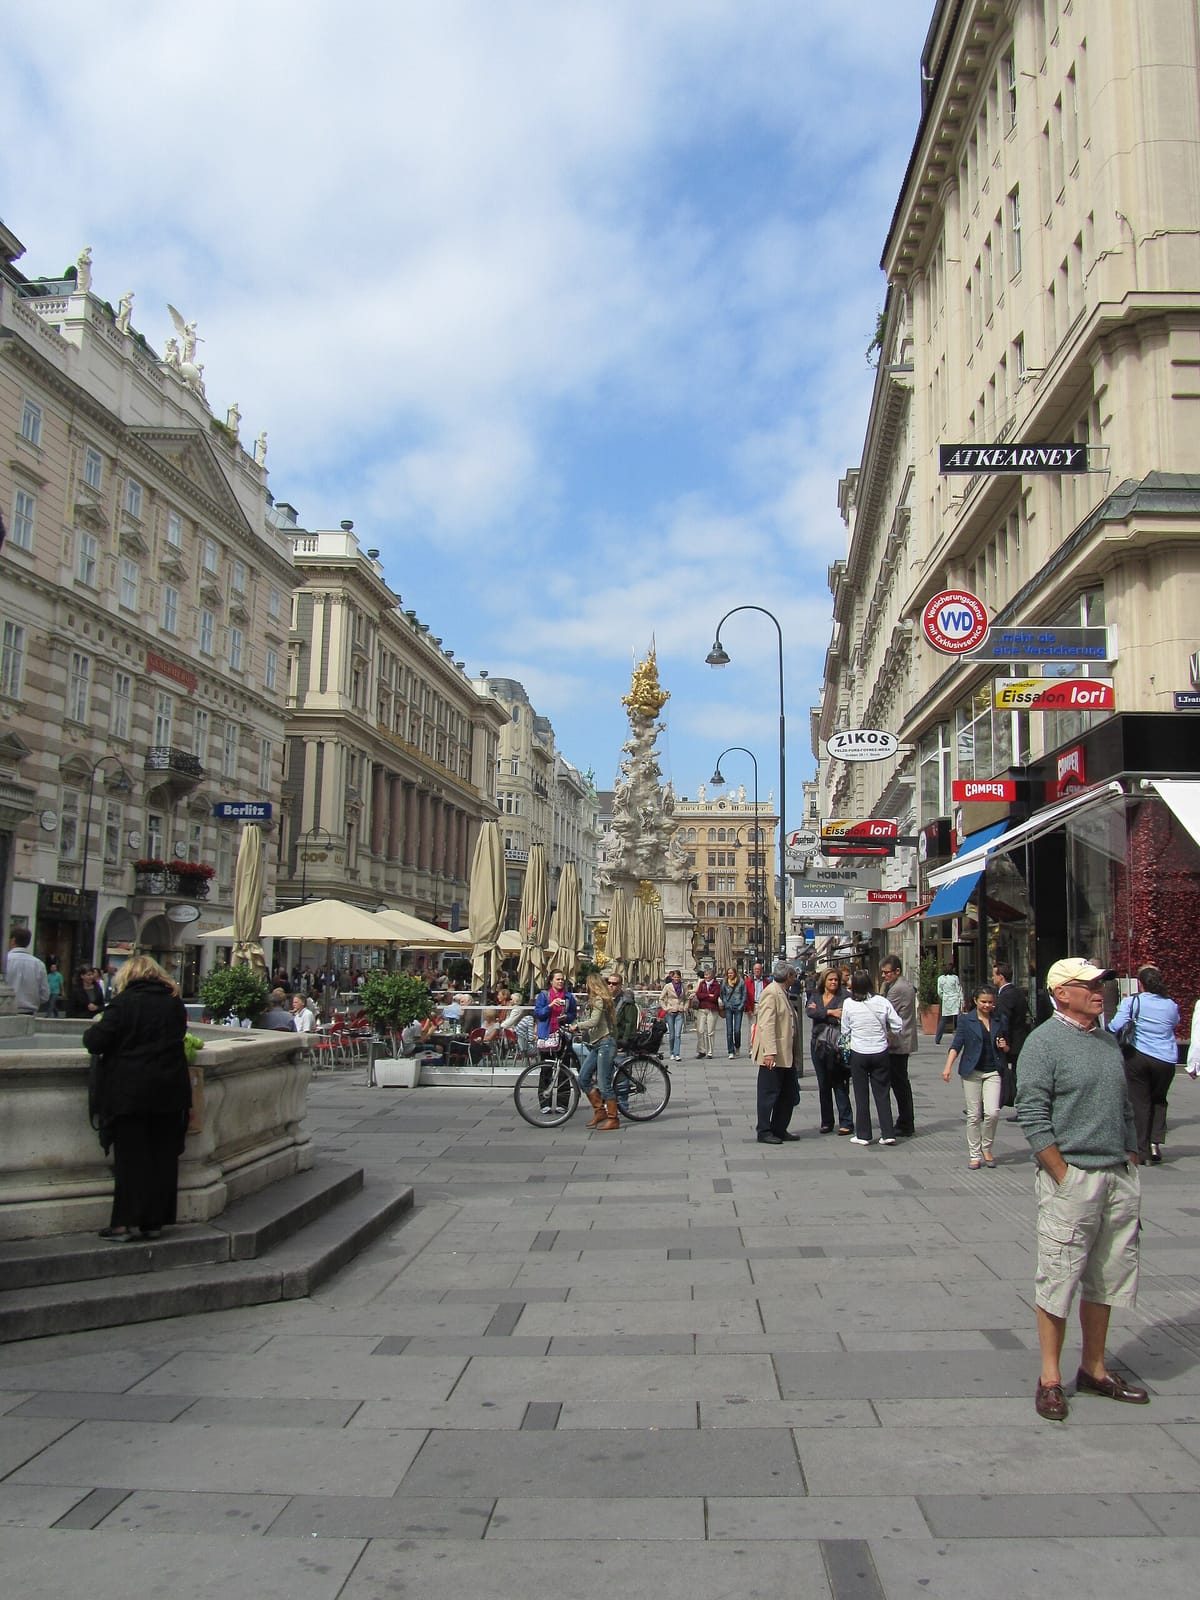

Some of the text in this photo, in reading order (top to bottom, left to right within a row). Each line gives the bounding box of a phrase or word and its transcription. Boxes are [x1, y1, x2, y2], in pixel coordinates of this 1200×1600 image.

[945, 449, 1082, 466] ATKEARNEY
[927, 594, 984, 620] Versicherungsdienst
[940, 611, 973, 631] VVD
[928, 623, 983, 649] mit Exklusivservice
[1037, 632, 1056, 643] als
[993, 645, 1105, 659] eine Versicherung
[1002, 690, 1065, 703] Eissalon
[835, 733, 890, 748] ZIKOS
[965, 783, 1004, 797] CAMPER
[223, 804, 265, 815] Berlitz
[872, 892, 897, 900] Triumph
[801, 900, 837, 909] BRAMO
